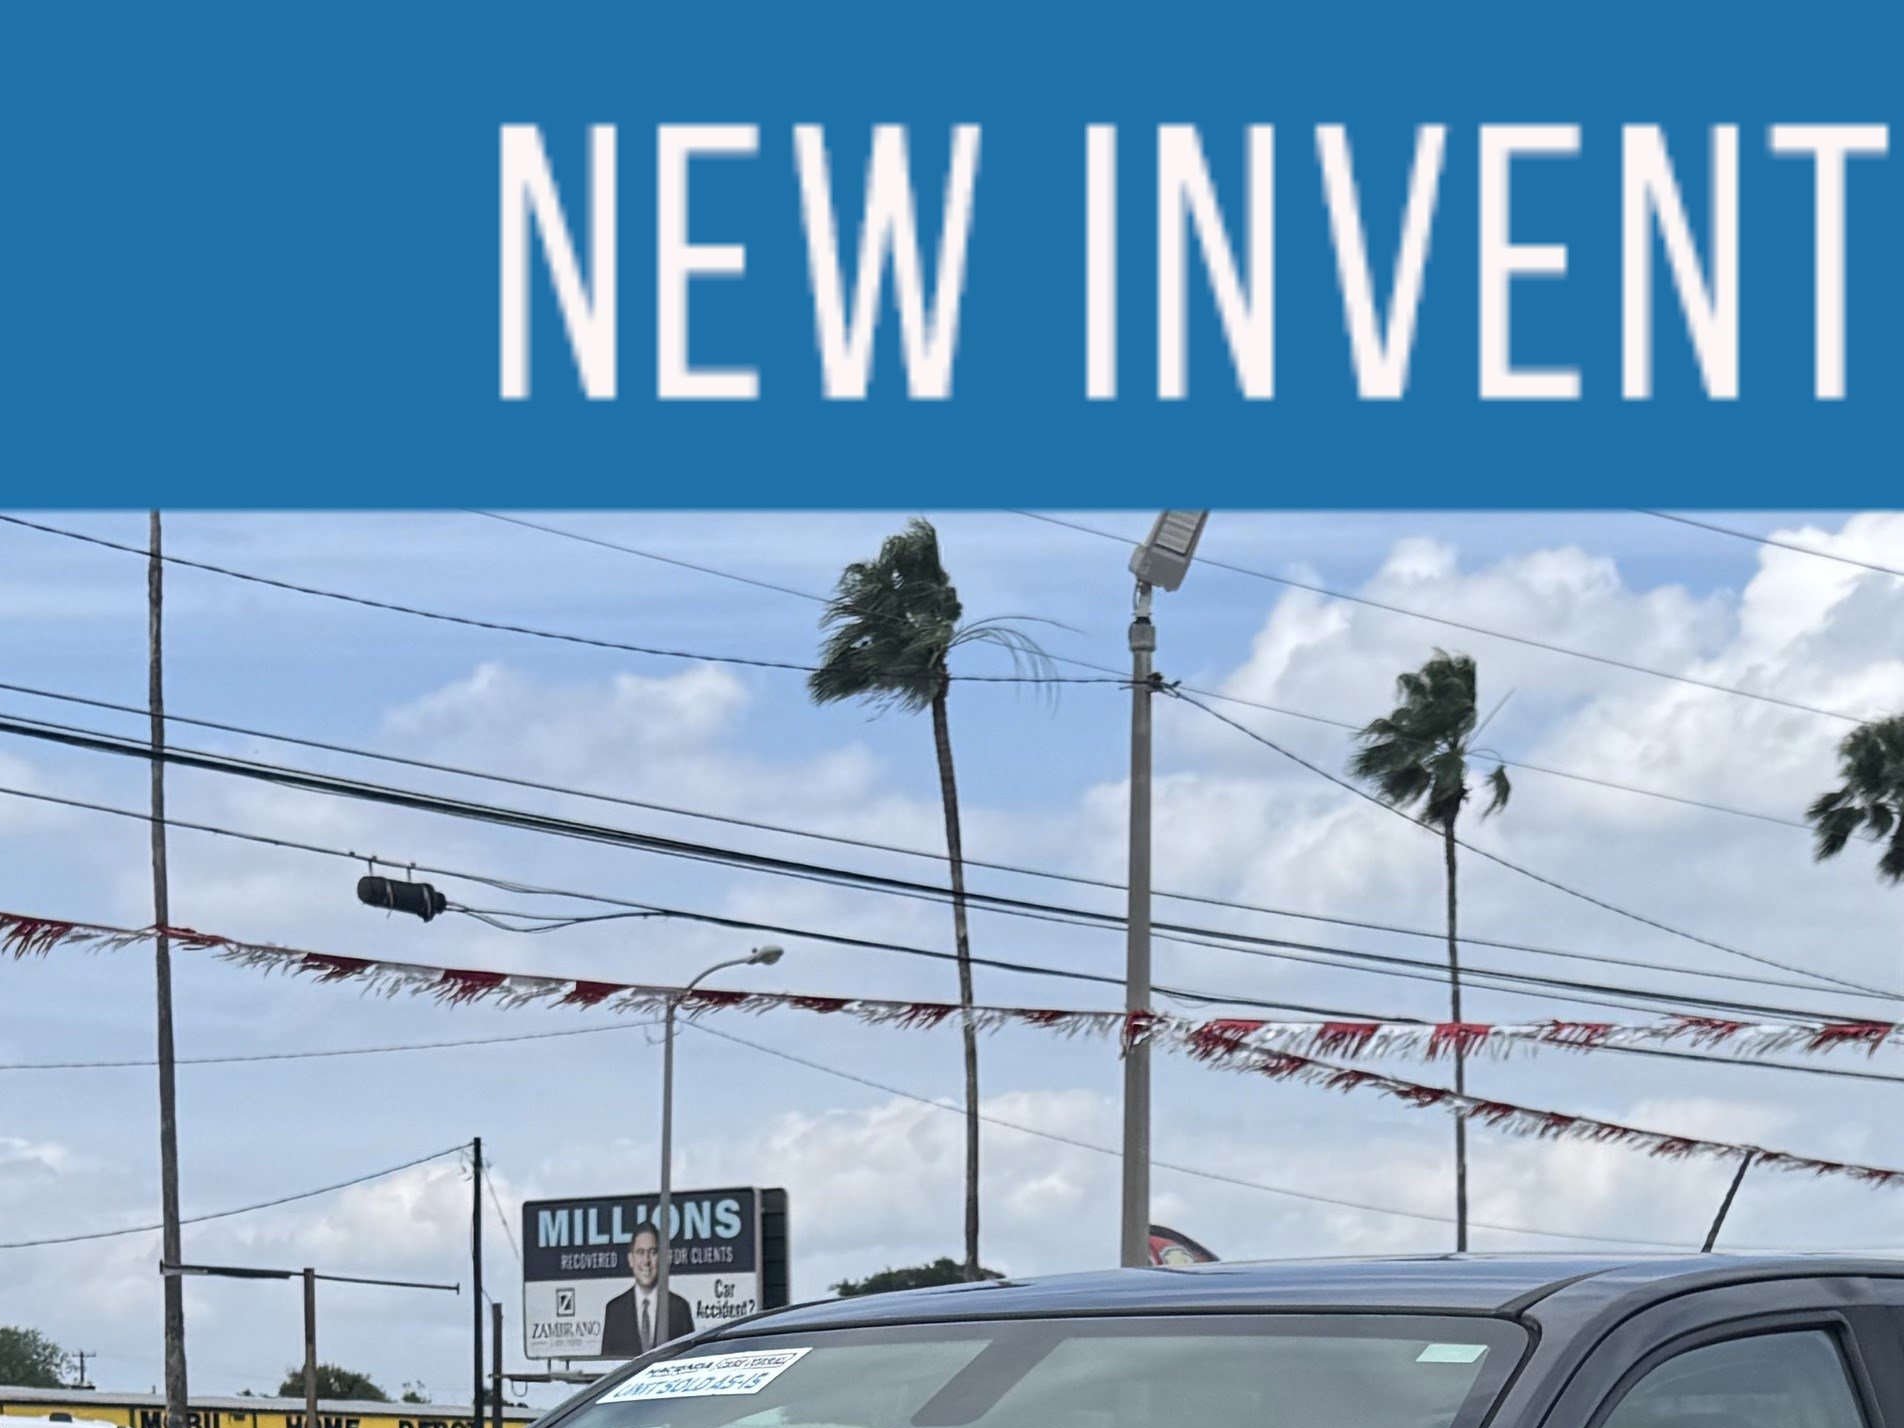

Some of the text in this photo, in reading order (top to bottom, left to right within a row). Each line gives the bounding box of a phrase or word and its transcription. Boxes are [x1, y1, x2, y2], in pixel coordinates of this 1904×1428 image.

[560, 1246, 734, 1271] RECOVERED OR CLIENTS
[713, 1278, 736, 1298] Car
[696, 1298, 756, 1320] Accident?
